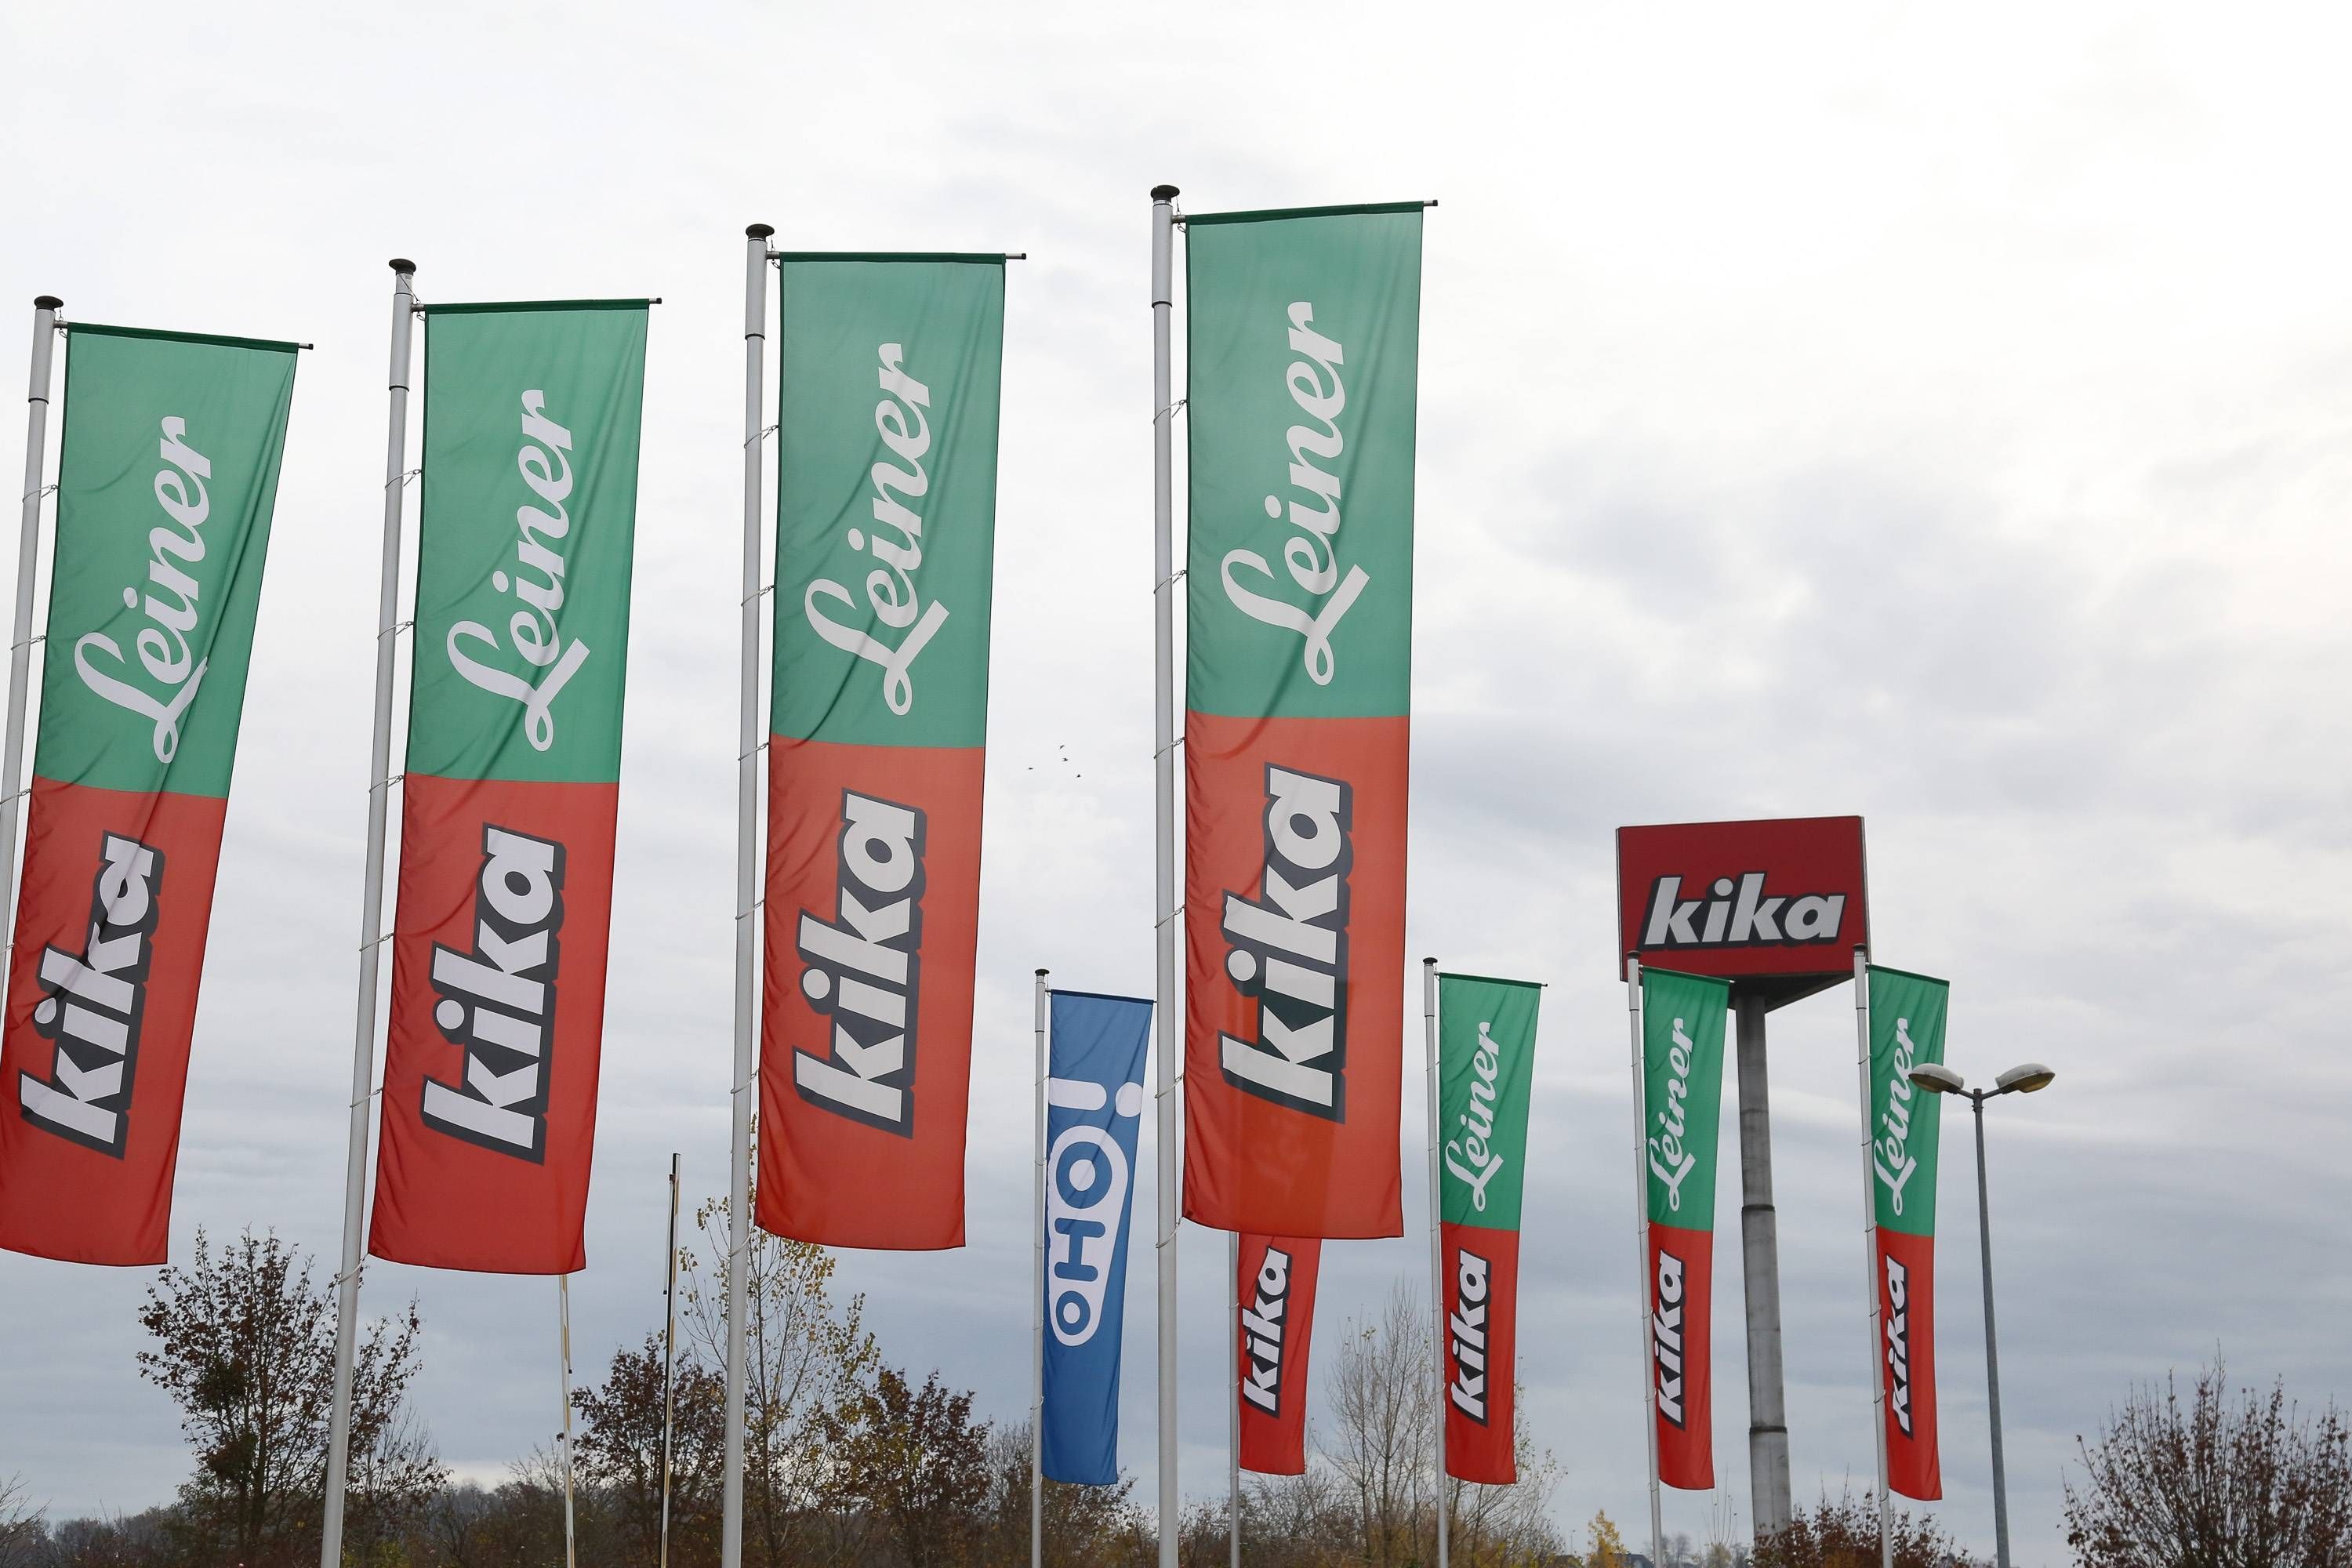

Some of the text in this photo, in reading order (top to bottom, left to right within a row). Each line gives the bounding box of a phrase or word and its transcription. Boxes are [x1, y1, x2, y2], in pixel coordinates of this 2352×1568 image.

[73, 415, 212, 764] Leiner
[445, 388, 591, 753] Leiner
[804, 342, 951, 717] Leiner
[1220, 300, 1371, 687] Leiner
[19, 831, 163, 1151] kika
[421, 825, 560, 1156] kika
[793, 790, 920, 1129] kika
[1219, 764, 1347, 1113] kika
[1644, 872, 1847, 946] kika
[1444, 1021, 1504, 1213] Leiner
[1649, 1017, 1697, 1212] Leiner
[1873, 1017, 1917, 1218] Leiner
[1243, 1247, 1290, 1414] kika
[1450, 1249, 1489, 1422] kika
[1652, 1249, 1684, 1427] kika
[1886, 1254, 1911, 1436] kika
